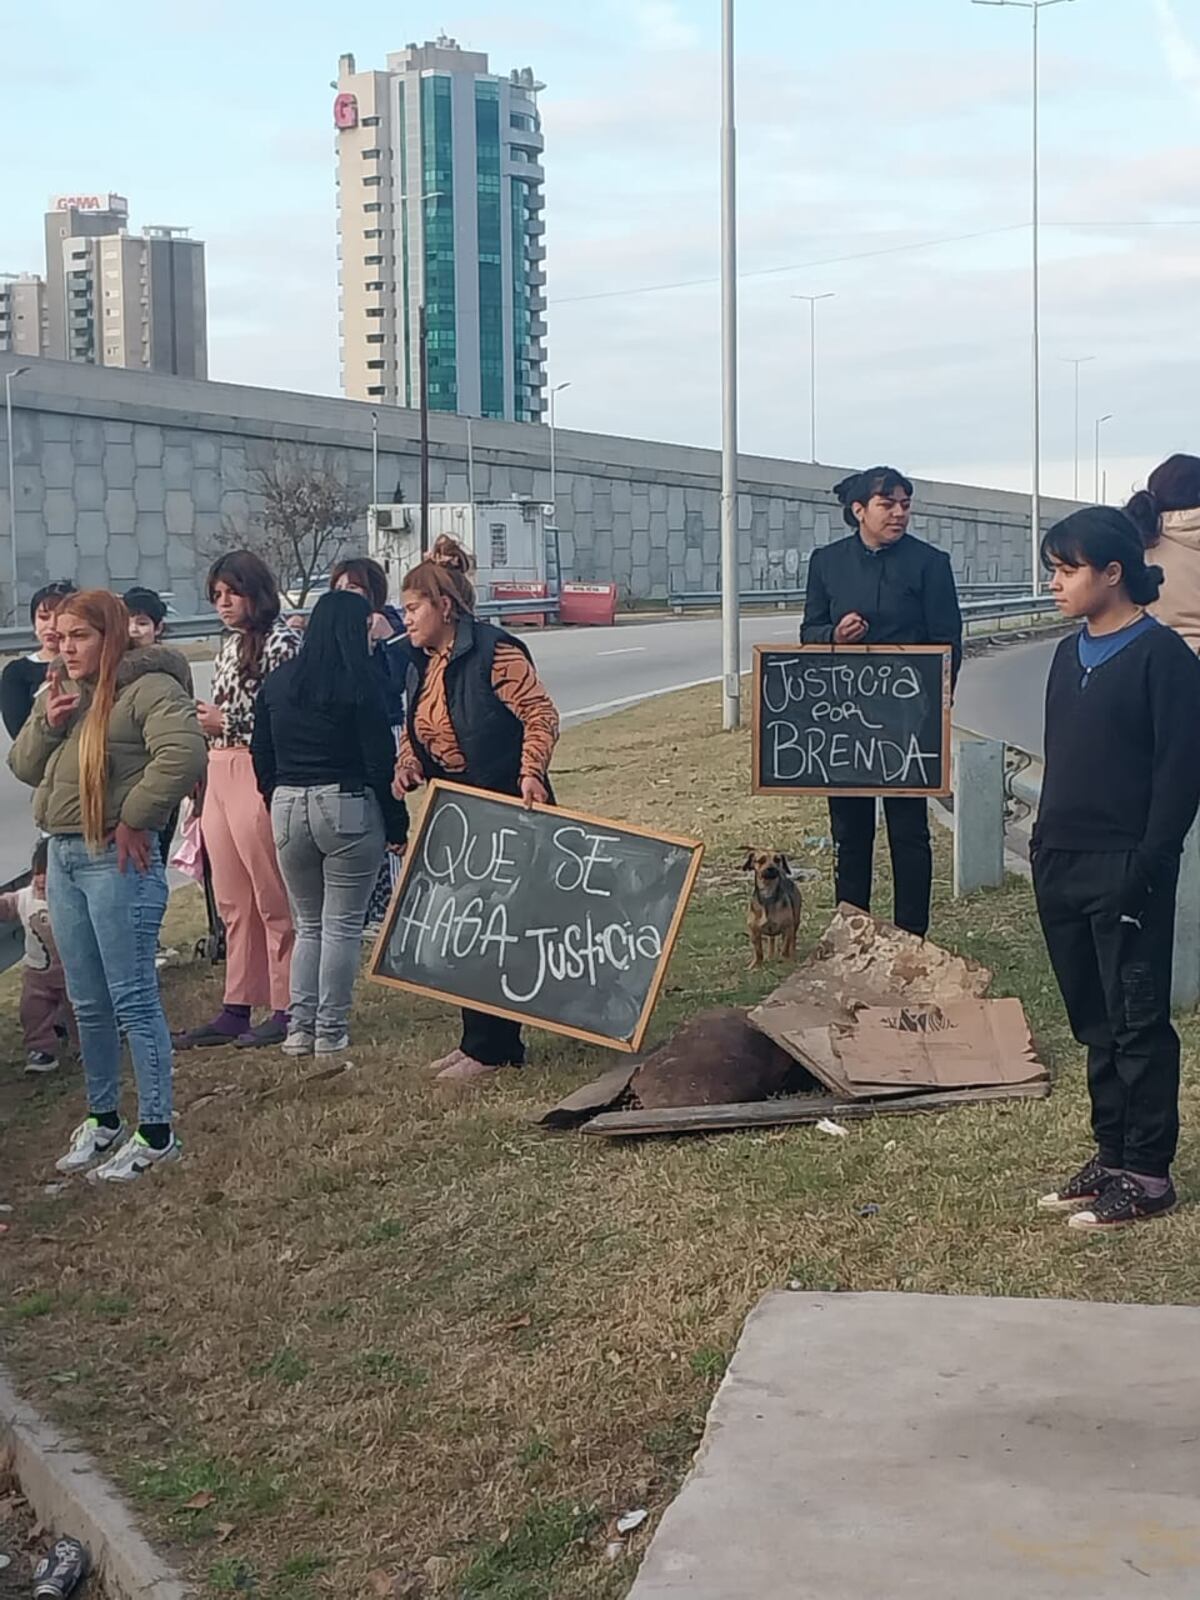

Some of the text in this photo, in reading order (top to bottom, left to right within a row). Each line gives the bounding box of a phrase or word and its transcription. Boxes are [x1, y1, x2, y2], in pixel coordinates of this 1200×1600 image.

[334, 93, 359, 129] G
[766, 720, 939, 785] BRENDA
[423, 802, 621, 896] QUE SE
[400, 885, 519, 966] HAGA
